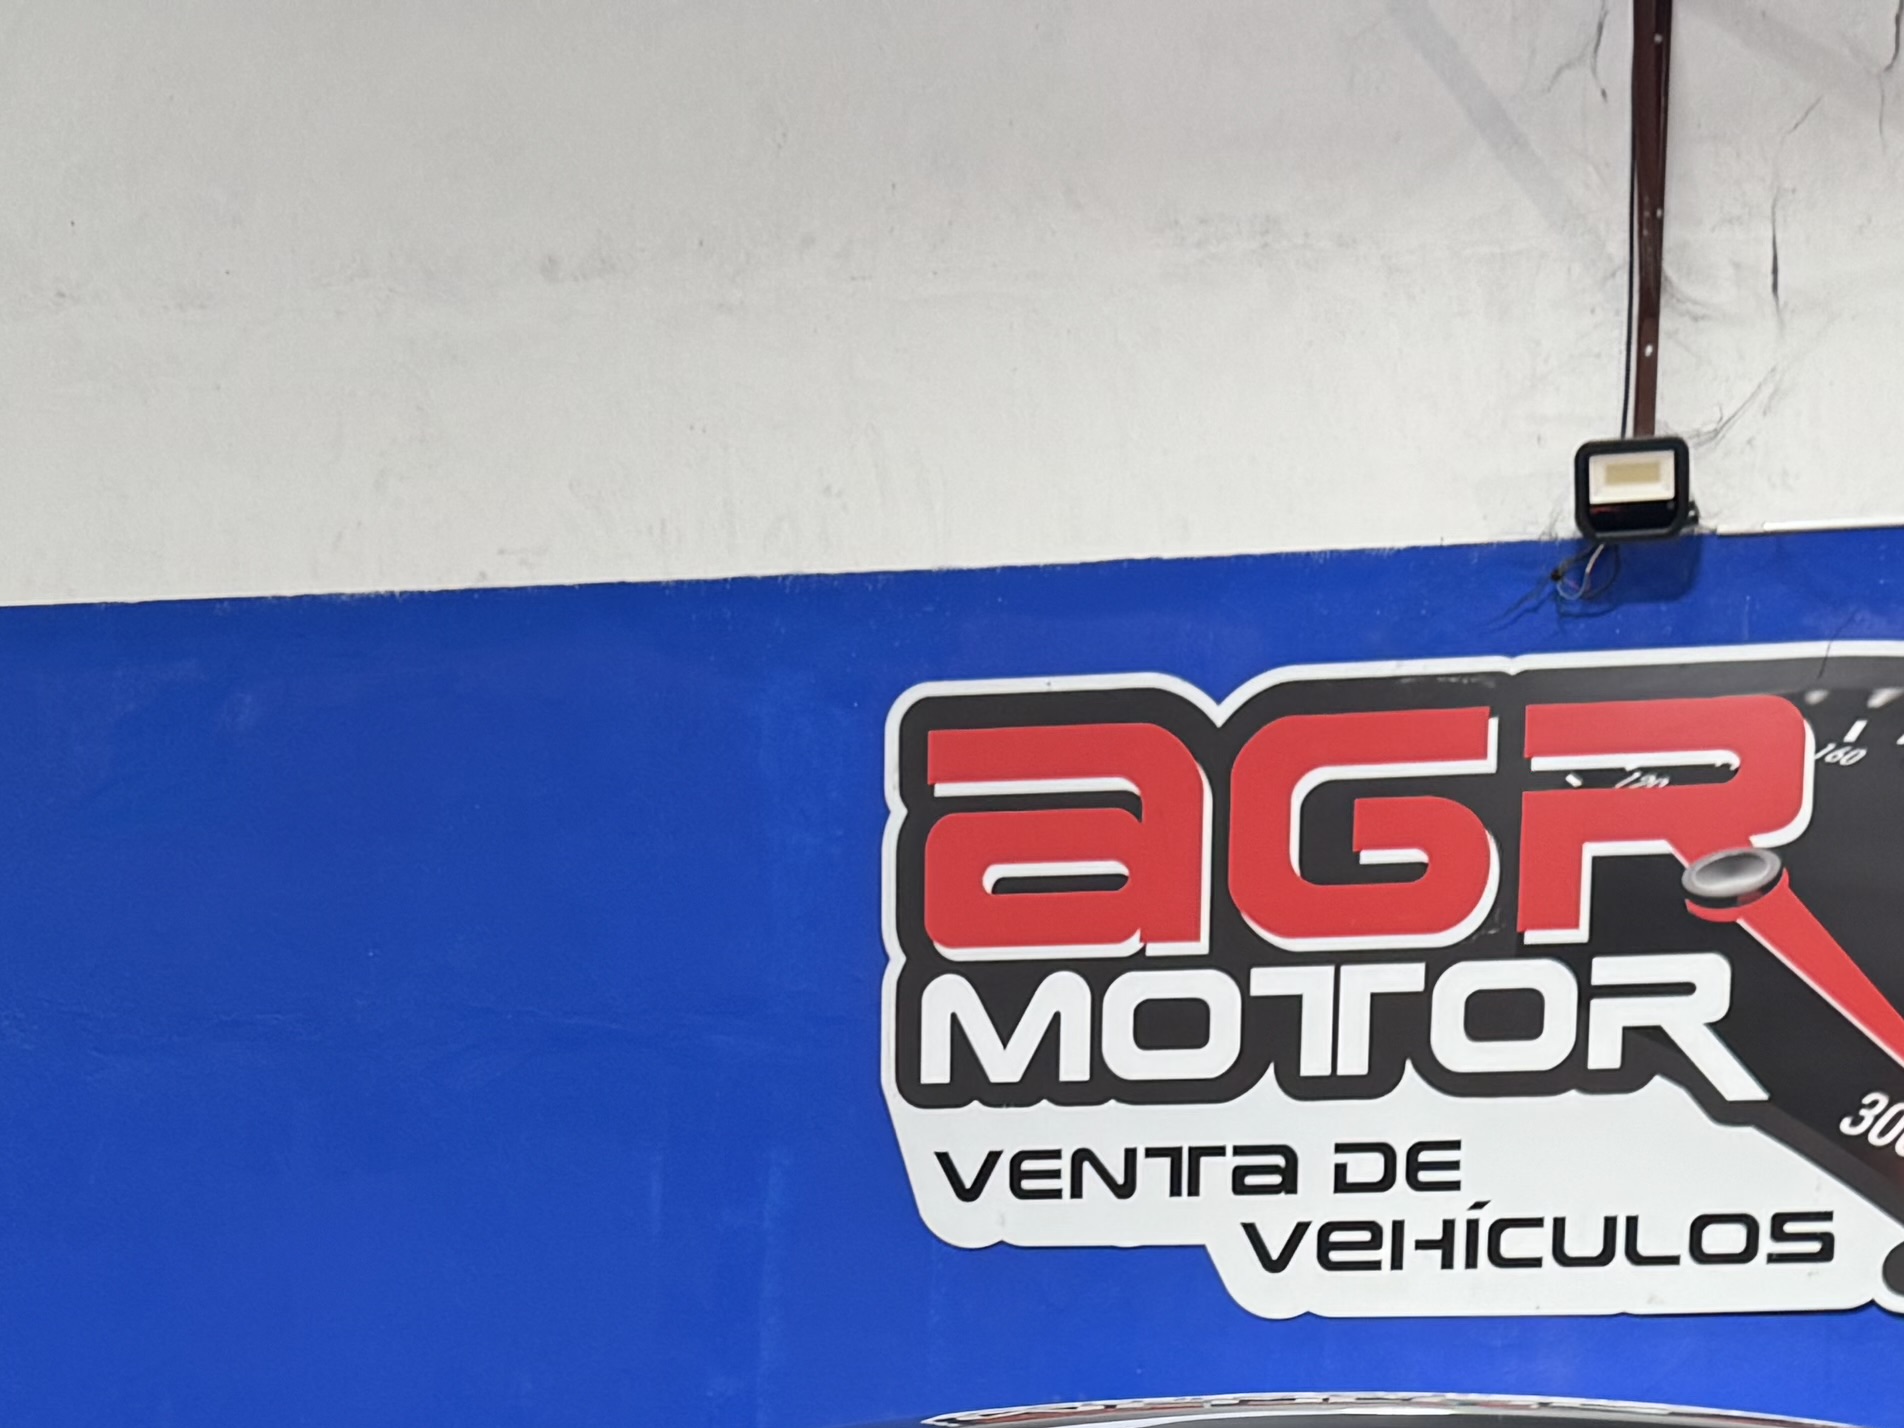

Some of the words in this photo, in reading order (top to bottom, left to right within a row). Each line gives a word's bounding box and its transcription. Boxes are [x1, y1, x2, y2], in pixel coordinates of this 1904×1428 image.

[1815, 743, 1868, 766] 160
[919, 952, 1770, 1102] MOTOR
[1332, 1139, 1463, 1194] DE
